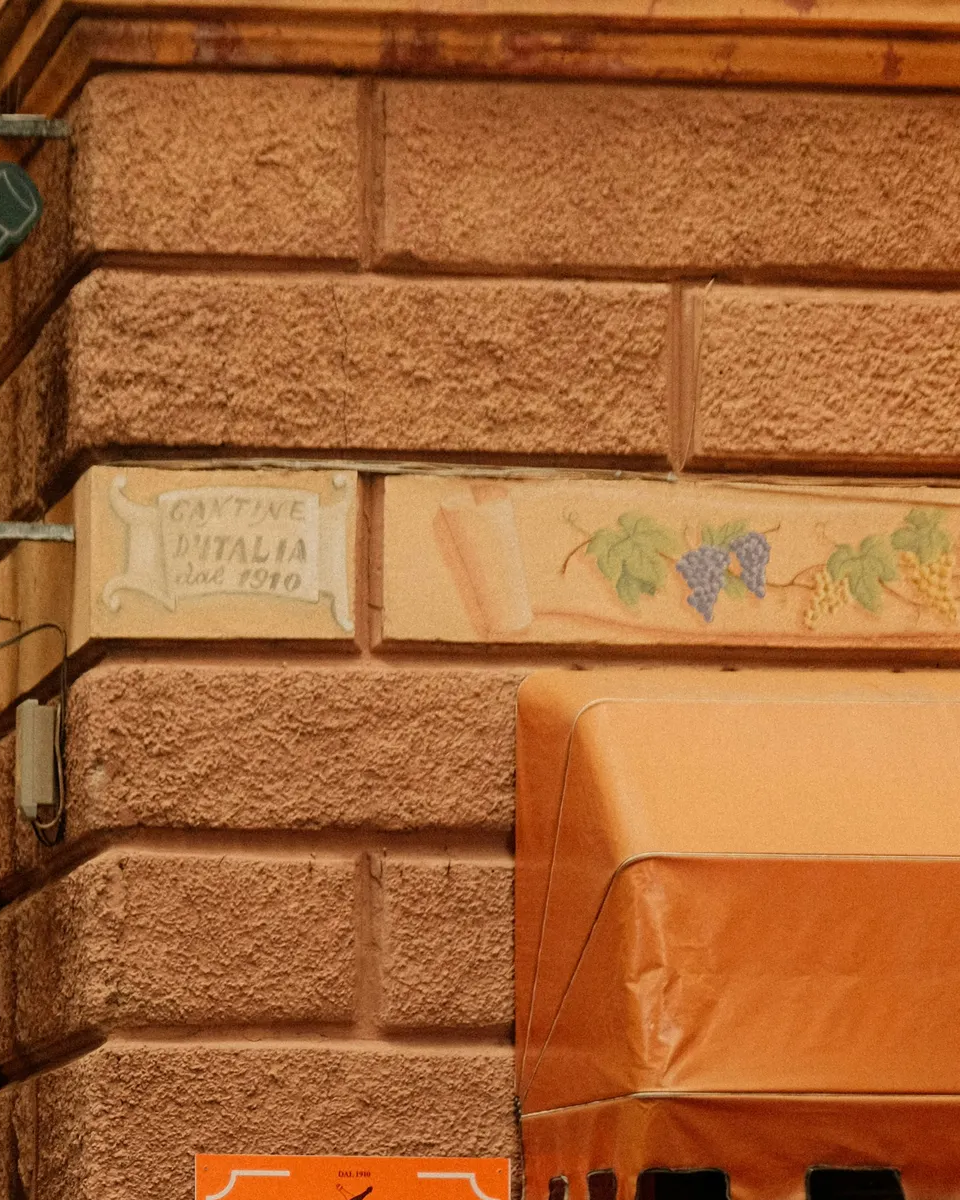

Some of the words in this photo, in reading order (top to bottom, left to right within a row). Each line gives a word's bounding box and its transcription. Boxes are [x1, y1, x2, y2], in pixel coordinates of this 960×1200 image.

[169, 496, 305, 526] CANTINE
[172, 534, 307, 564] D'ITALIA
[239, 567, 302, 592] 1910
[338, 1170, 354, 1178] DAL
